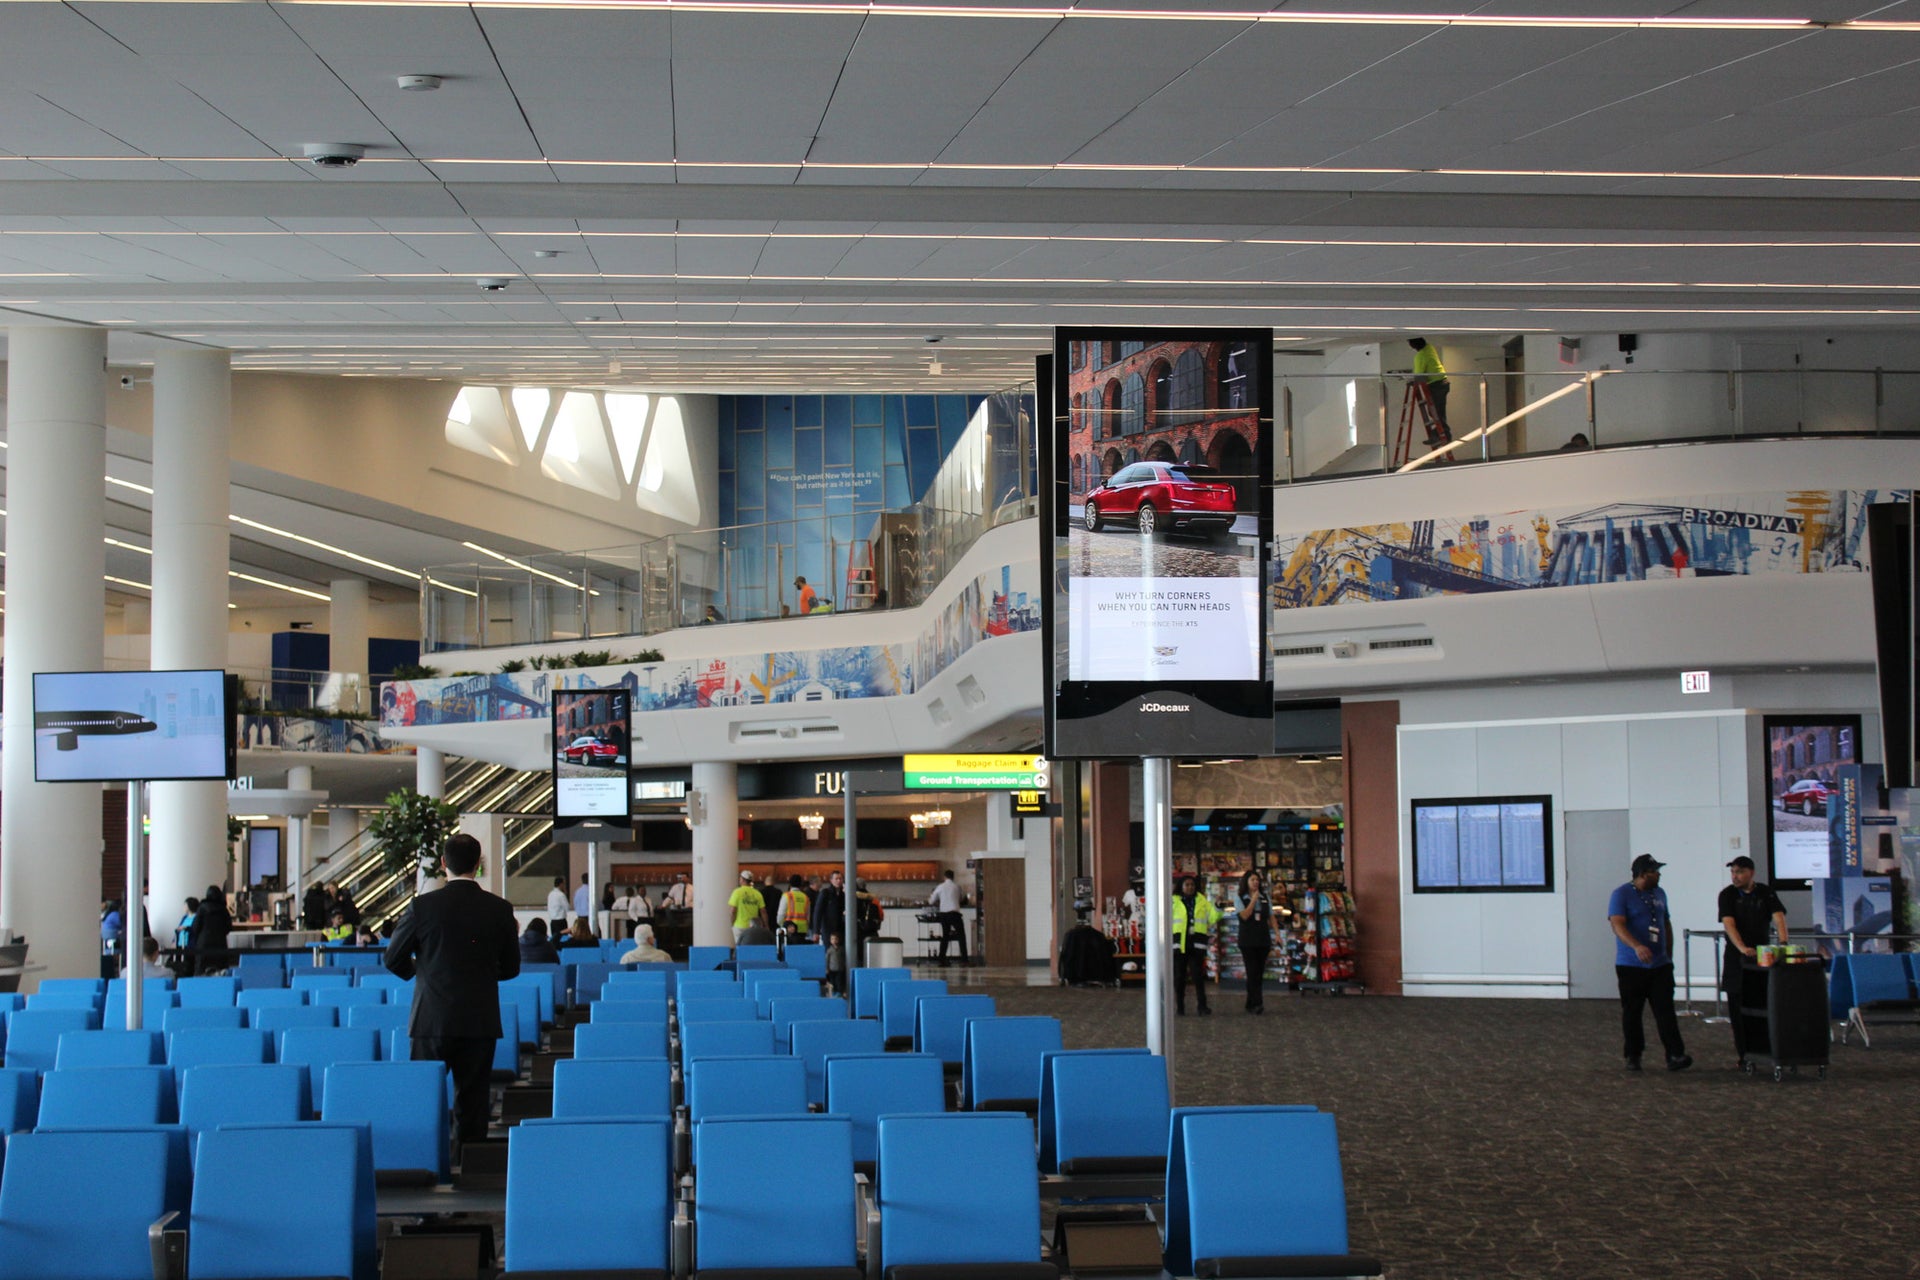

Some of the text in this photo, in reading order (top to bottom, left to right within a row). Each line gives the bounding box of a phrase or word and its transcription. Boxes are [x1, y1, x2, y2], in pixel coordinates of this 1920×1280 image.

[840, 471, 855, 479] York
[808, 481, 829, 489] rather
[1682, 508, 1804, 533] BROADWAY
[1498, 525, 1514, 535] OF
[1488, 534, 1527, 546] YORK
[1115, 592, 1211, 600] WHY TURN CORNERS
[1097, 603, 1231, 611] WHEN YOU CAN TURN HEADS
[1685, 673, 1707, 691] EXIT
[1140, 703, 1190, 712] JCDecaux
[956, 760, 992, 768] Baggage
[920, 776, 1018, 787] Ground Transportation
[1849, 778, 1857, 866] WELCOME TO
